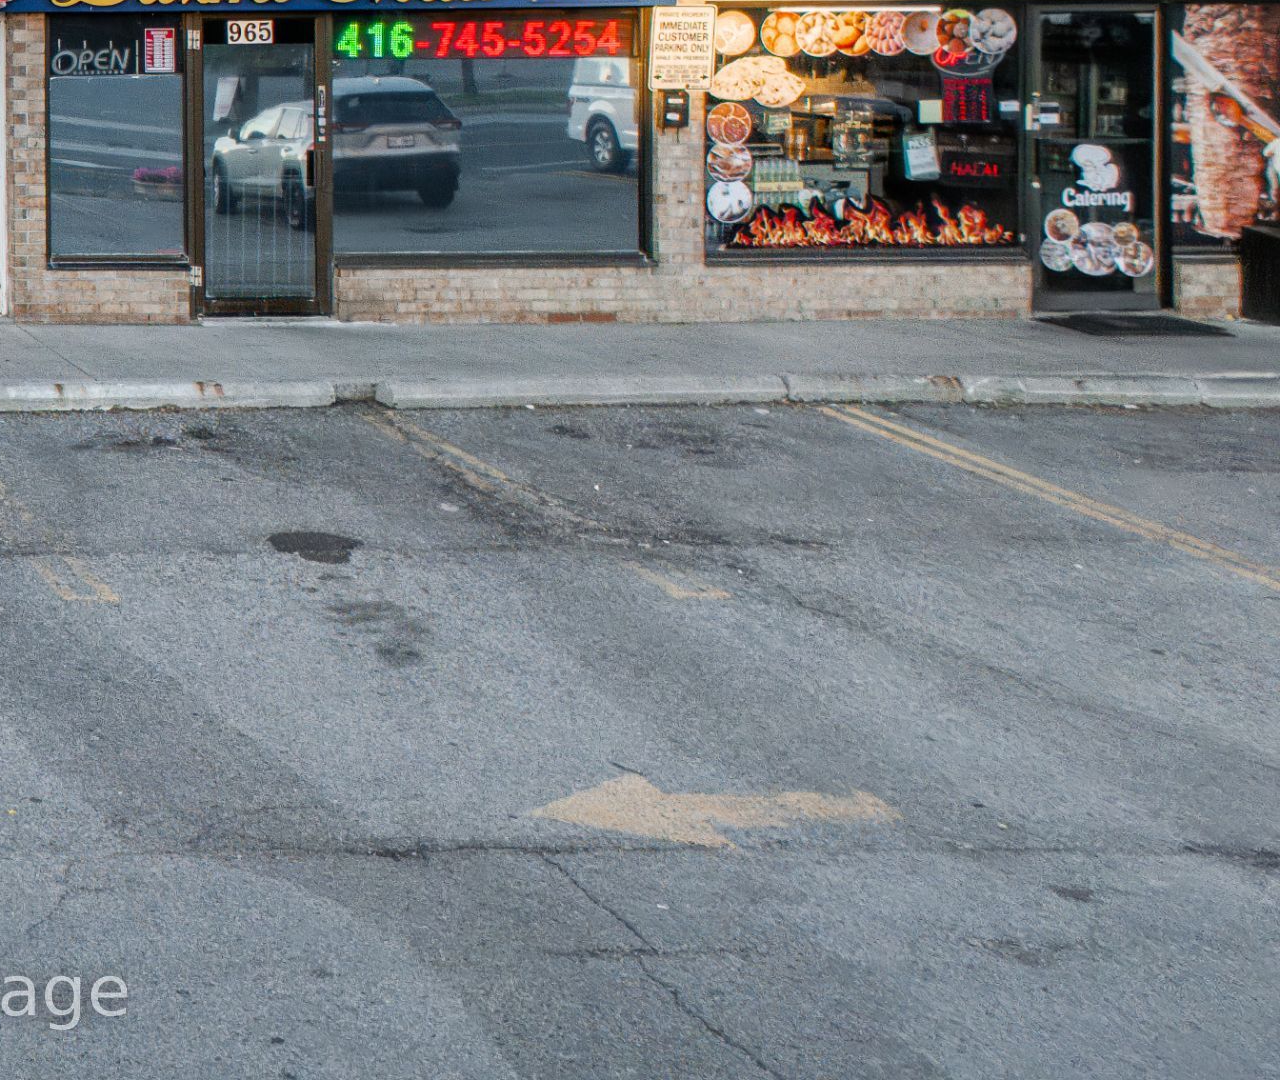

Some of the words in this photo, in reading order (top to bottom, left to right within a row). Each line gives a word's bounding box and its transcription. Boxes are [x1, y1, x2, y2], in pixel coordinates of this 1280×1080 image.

[229, 23, 271, 42] 965
[659, 21, 708, 31] IMMEDIATE
[337, 21, 621, 58] 416-745-5254
[658, 32, 709, 42] CUSTOMER
[655, 44, 688, 52] PARKING
[51, 48, 131, 75] OPEN
[1062, 187, 1131, 212] Catering
